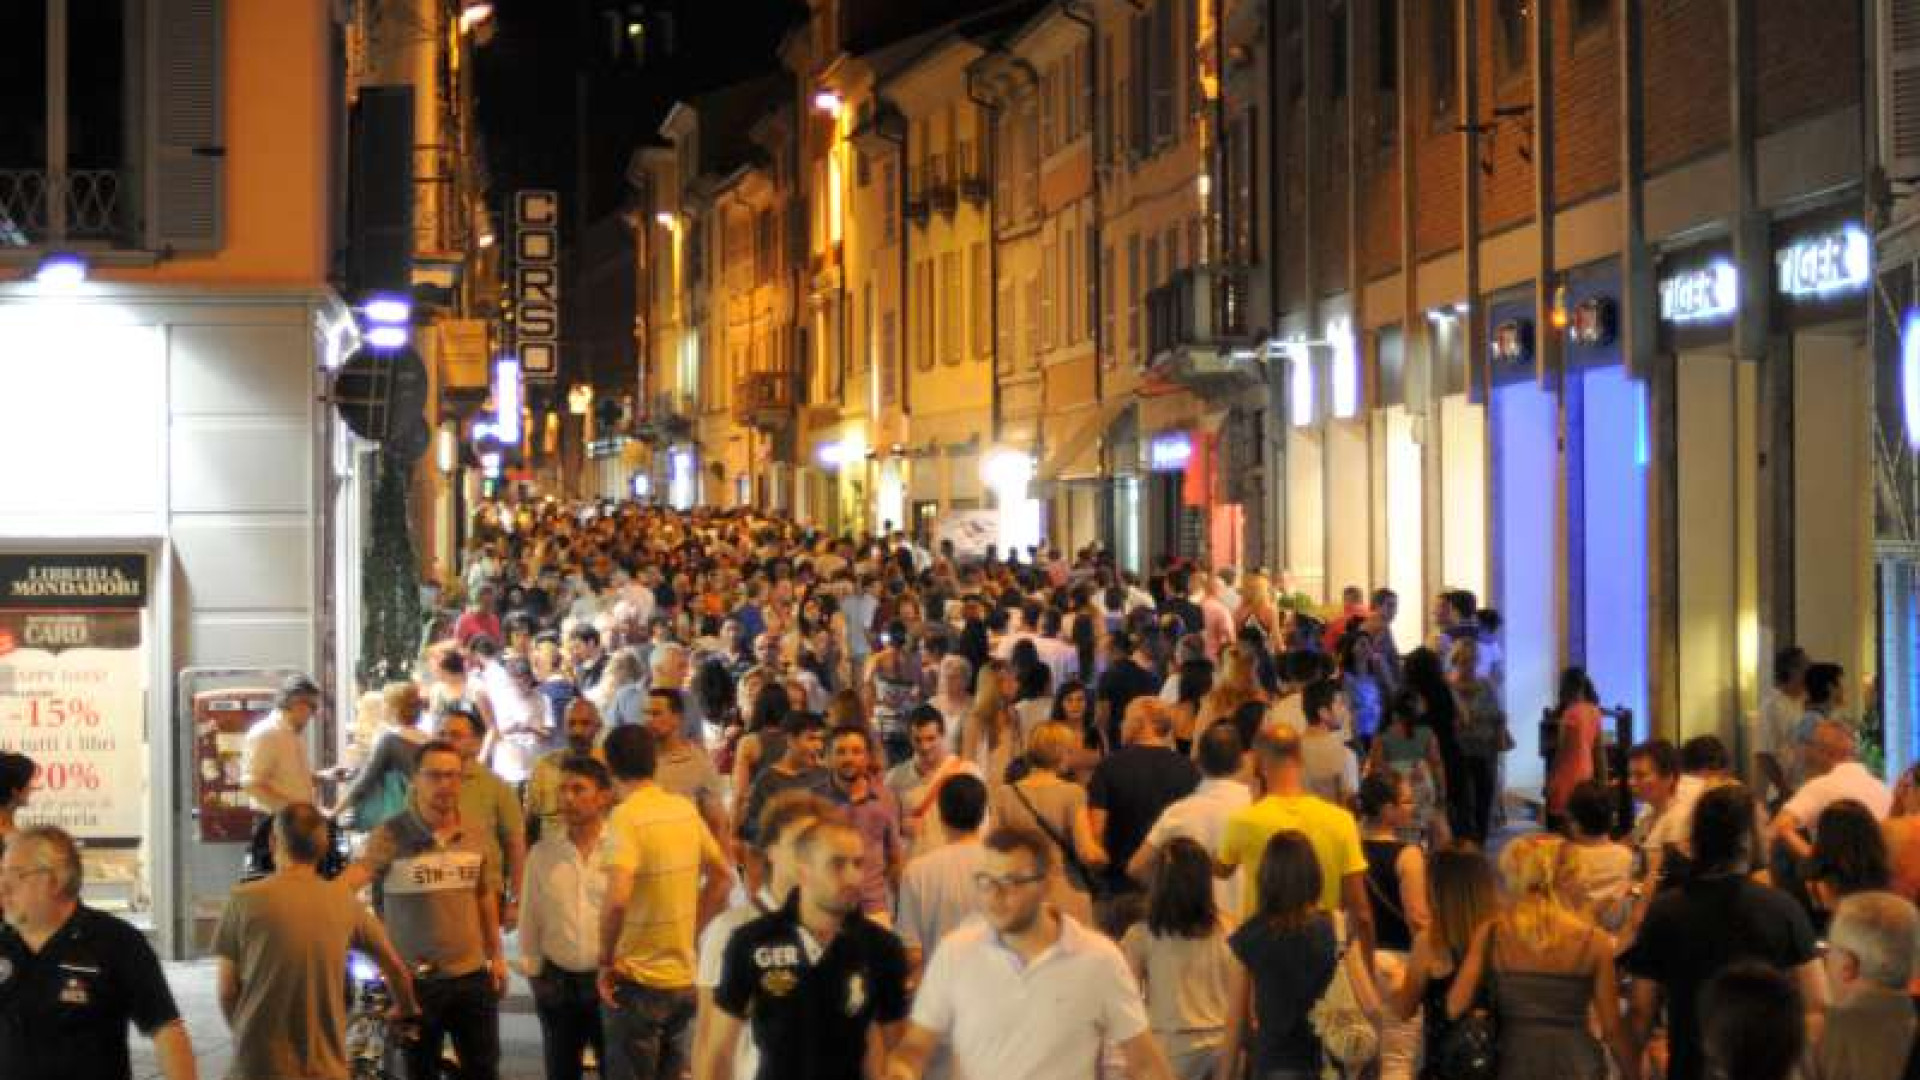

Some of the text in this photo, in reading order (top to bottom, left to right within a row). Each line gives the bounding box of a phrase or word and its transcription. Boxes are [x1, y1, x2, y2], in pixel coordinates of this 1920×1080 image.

[517, 190, 558, 378] CORSO
[28, 565, 124, 580] LIBRERIA
[11, 580, 140, 596] MONDADORI
[24, 622, 87, 644] CARD
[9, 697, 100, 728] -15%
